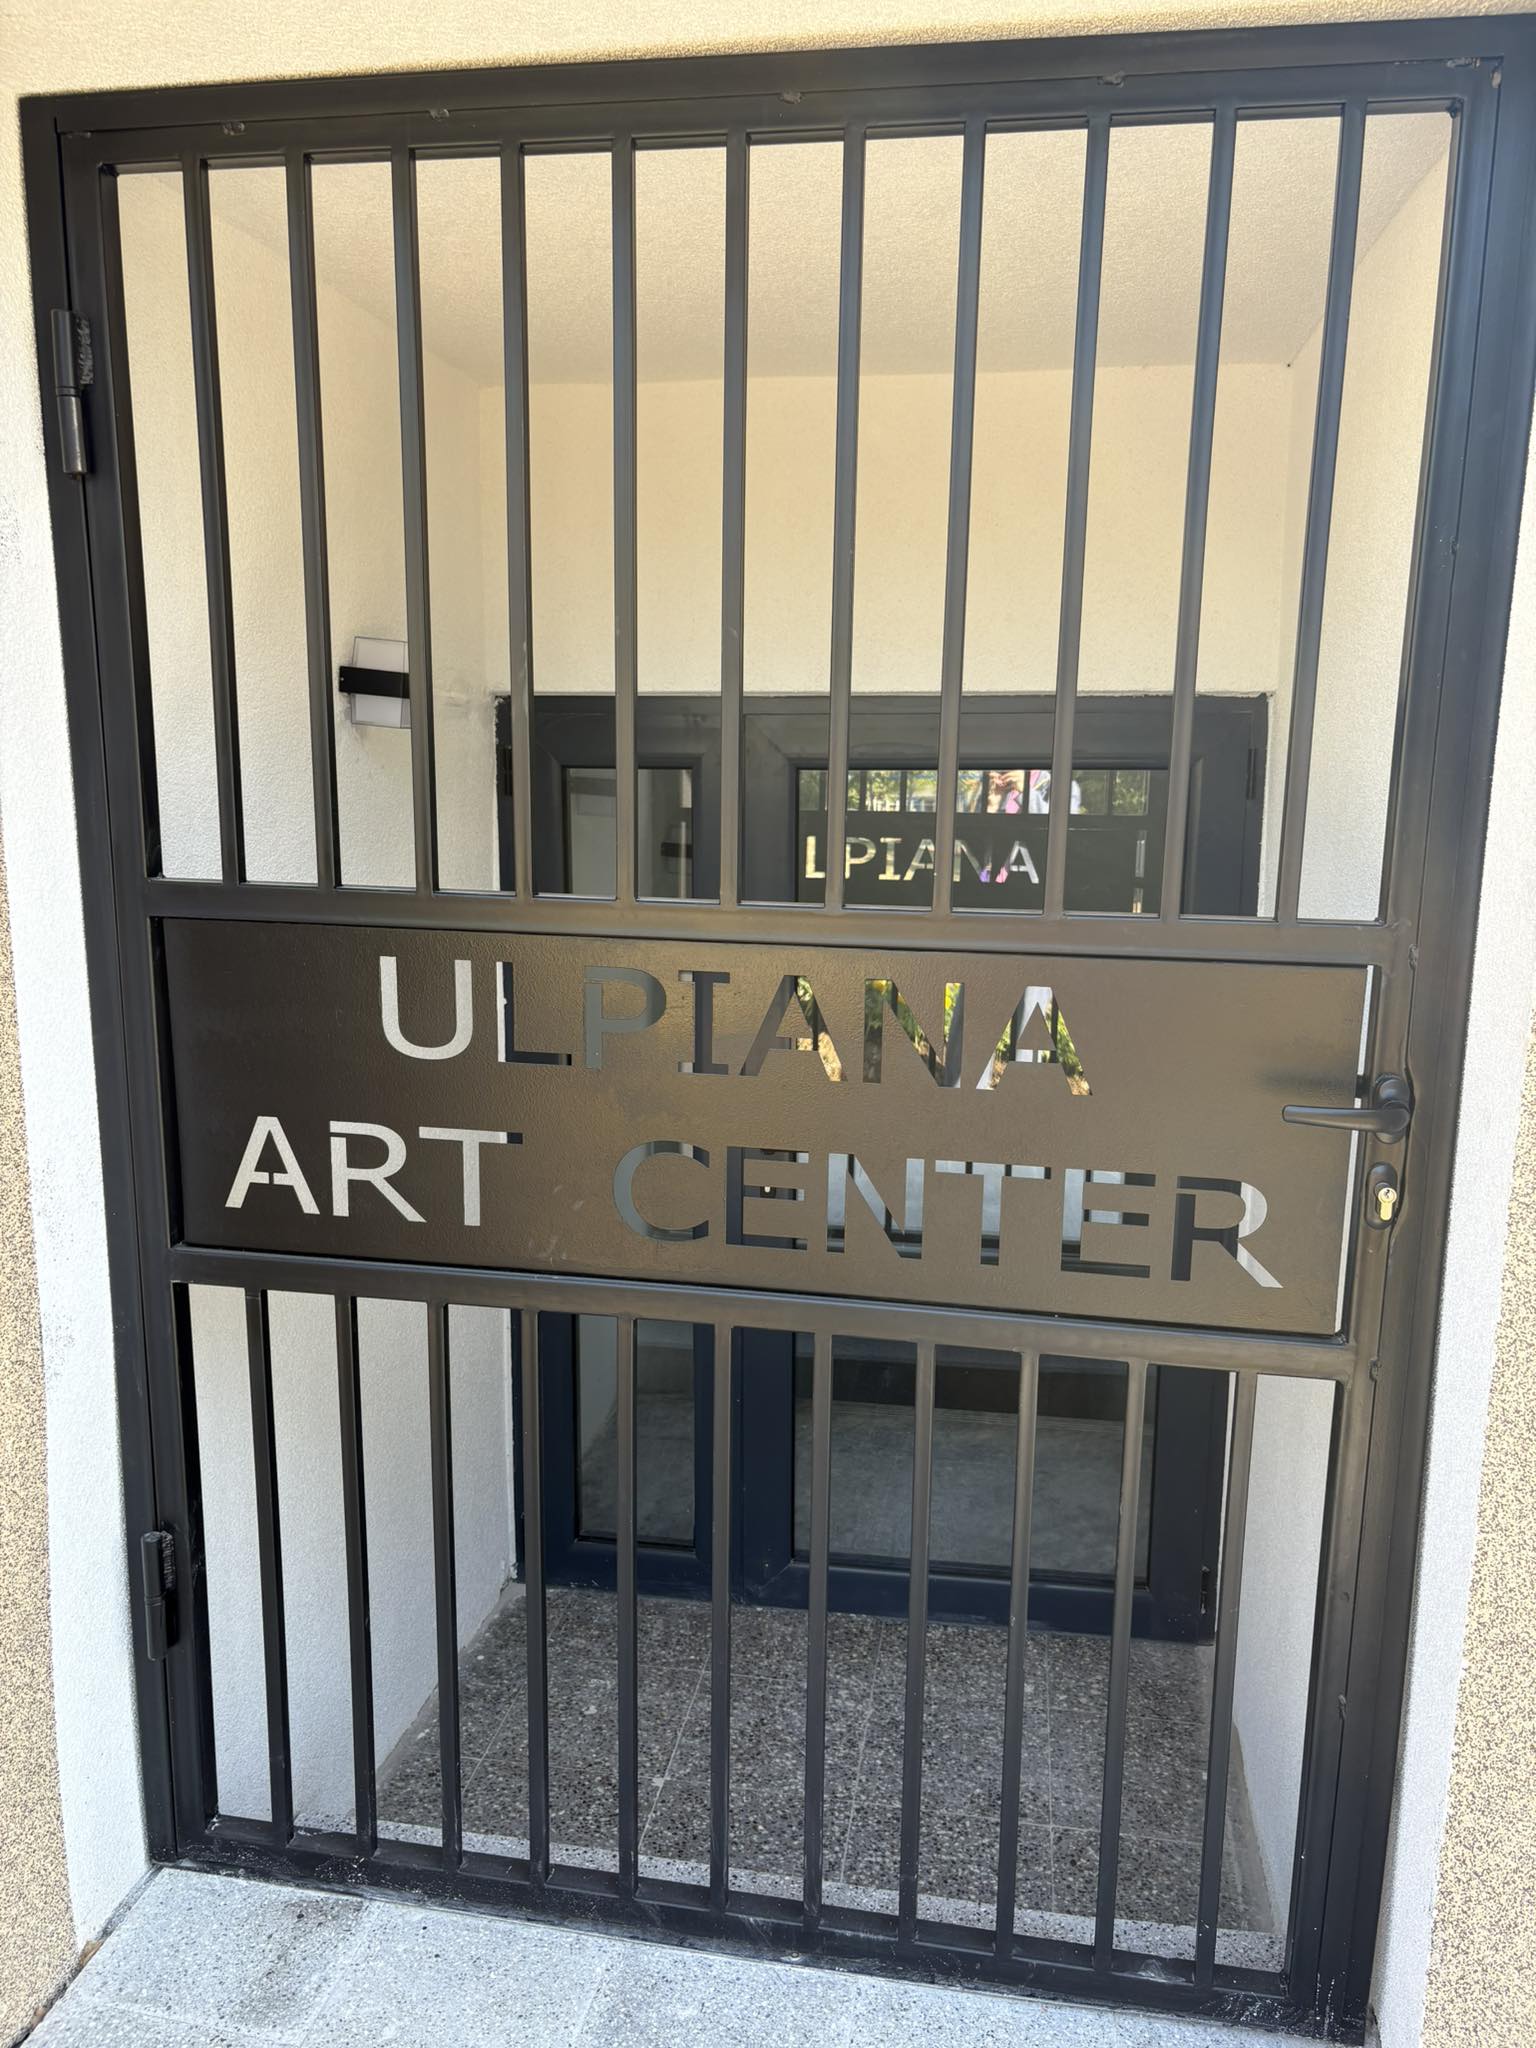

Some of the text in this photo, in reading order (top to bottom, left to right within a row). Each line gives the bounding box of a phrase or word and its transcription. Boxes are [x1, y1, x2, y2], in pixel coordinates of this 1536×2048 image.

[379, 955, 1094, 1097] ULPIANA
[225, 1116, 1284, 1289] ART CENTER
